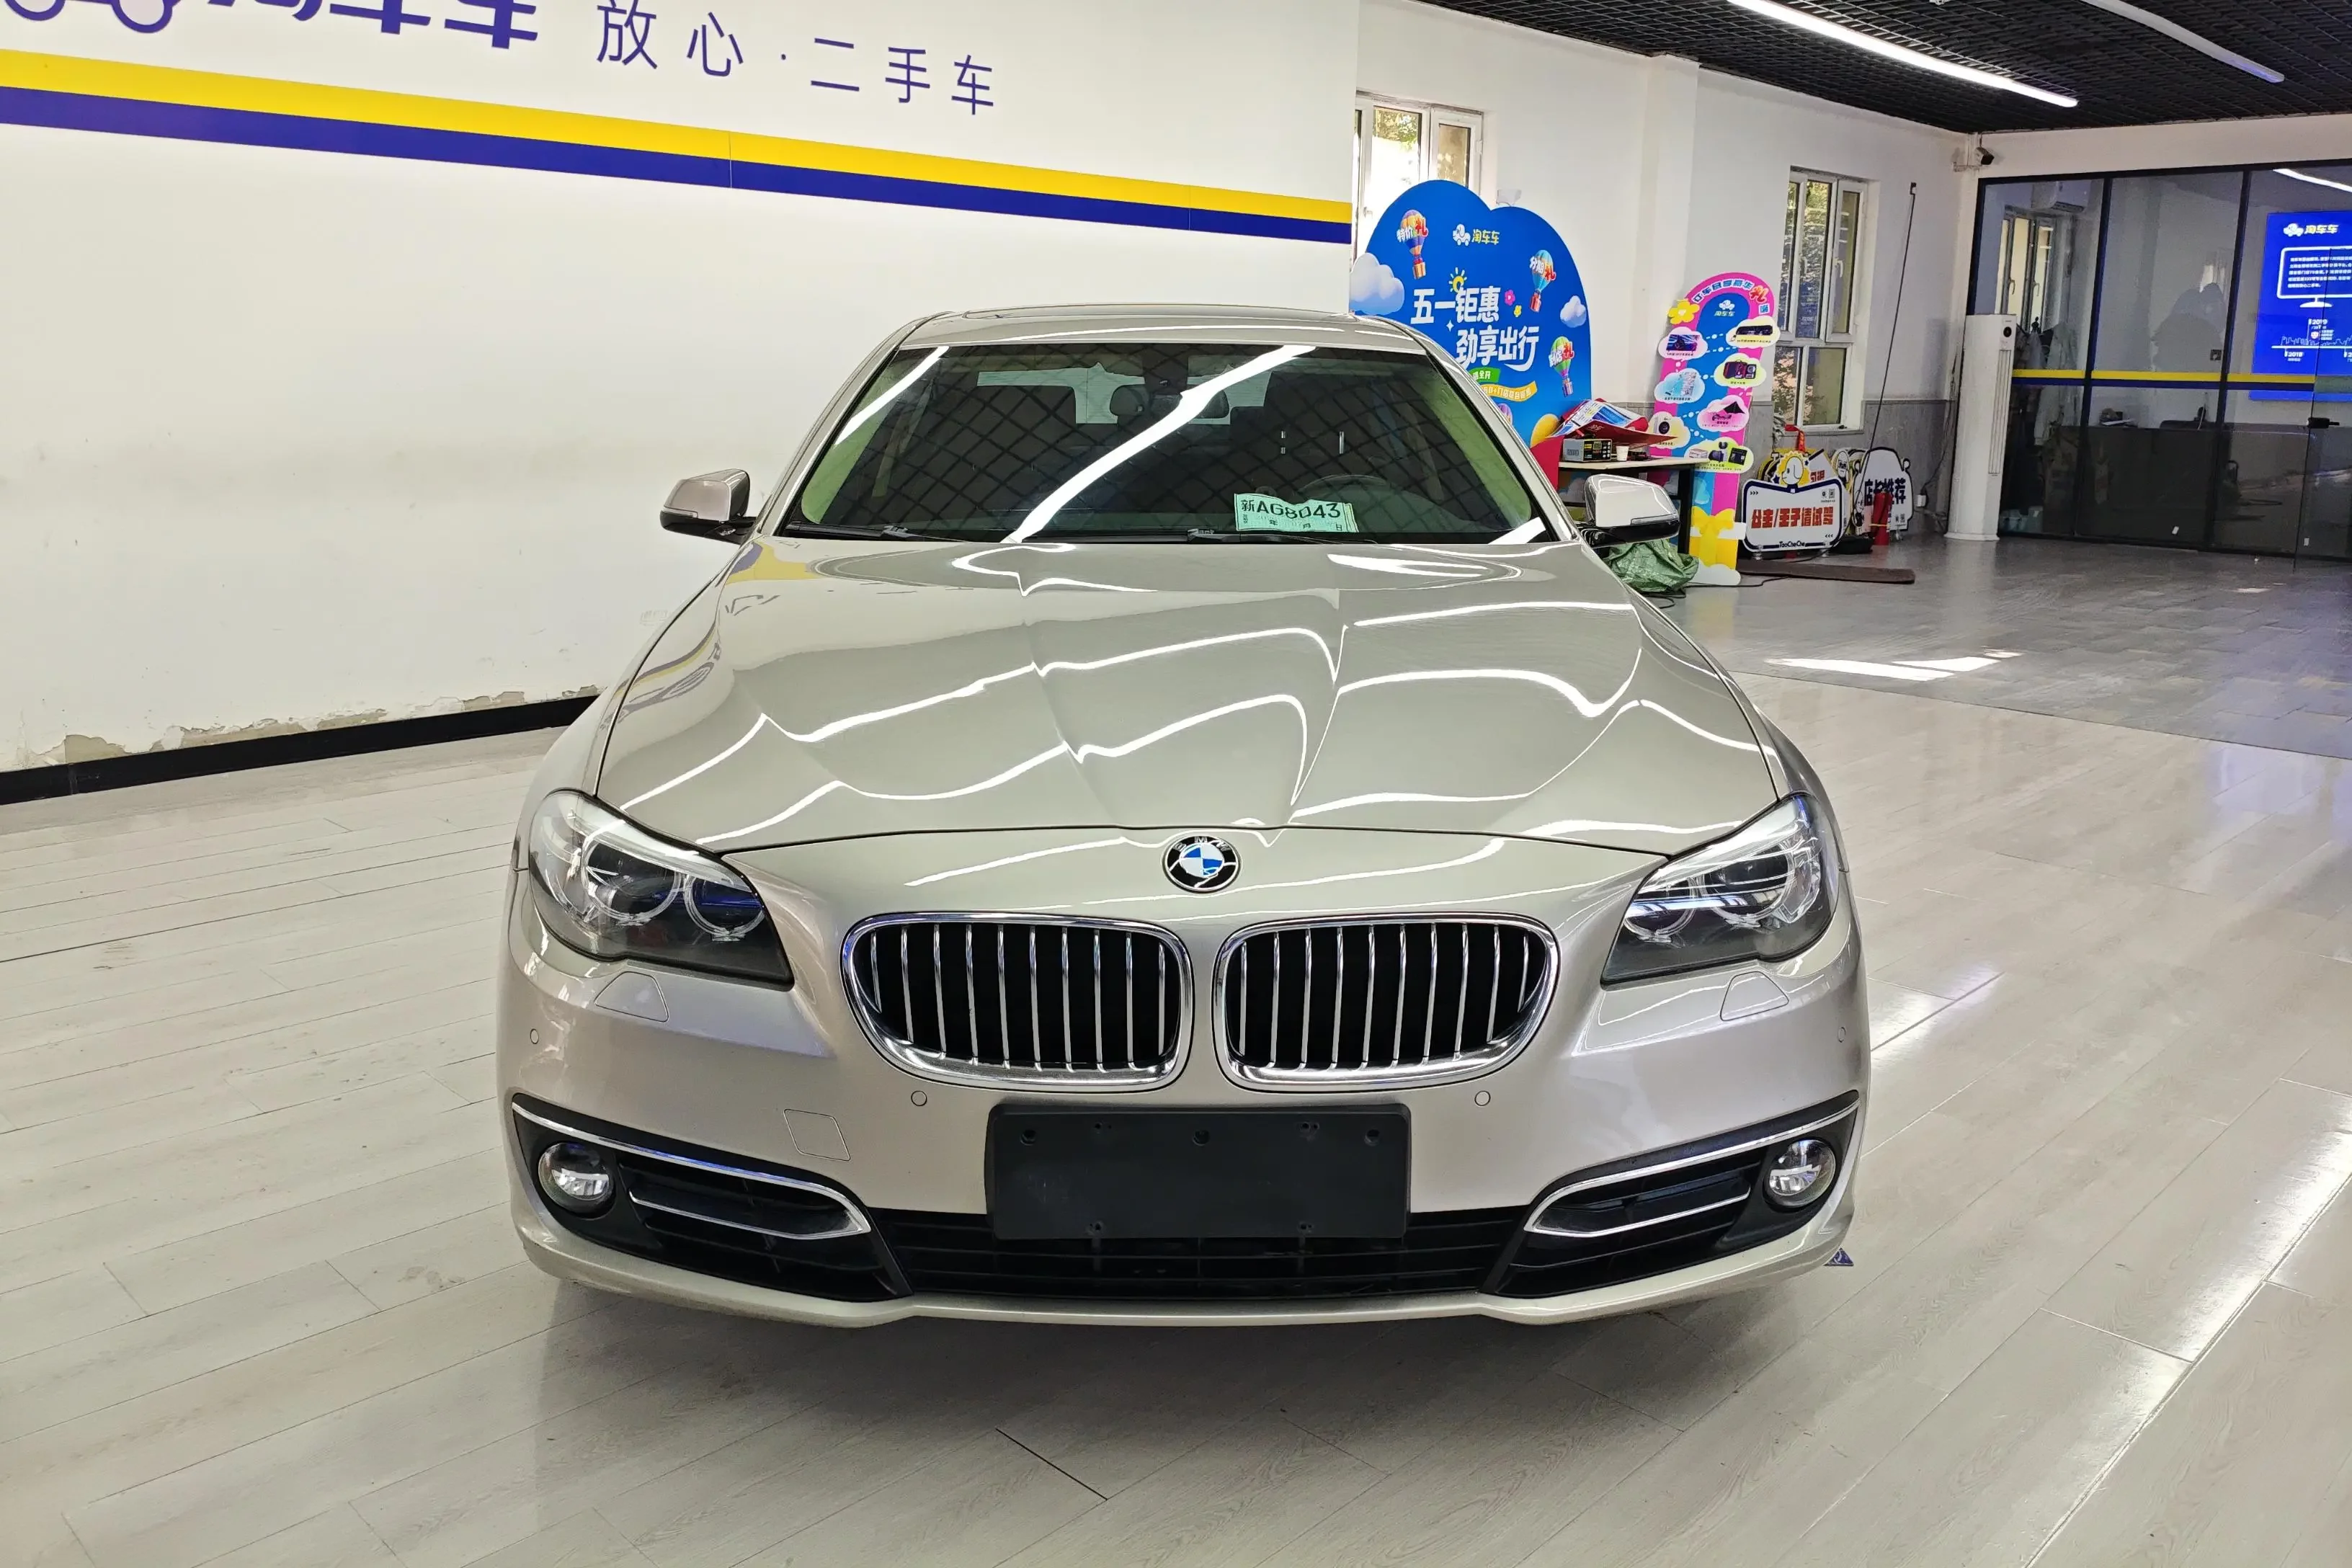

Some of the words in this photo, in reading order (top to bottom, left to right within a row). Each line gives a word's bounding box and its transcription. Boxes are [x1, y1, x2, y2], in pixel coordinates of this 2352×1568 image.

[1471, 228, 1500, 246] 淘车车
[1410, 285, 1501, 325] 五一钜惠
[1456, 324, 1540, 372] 劲享出行
[1751, 506, 1834, 529] 公主/王子请试驾
[1173, 835, 1231, 852] BMW
